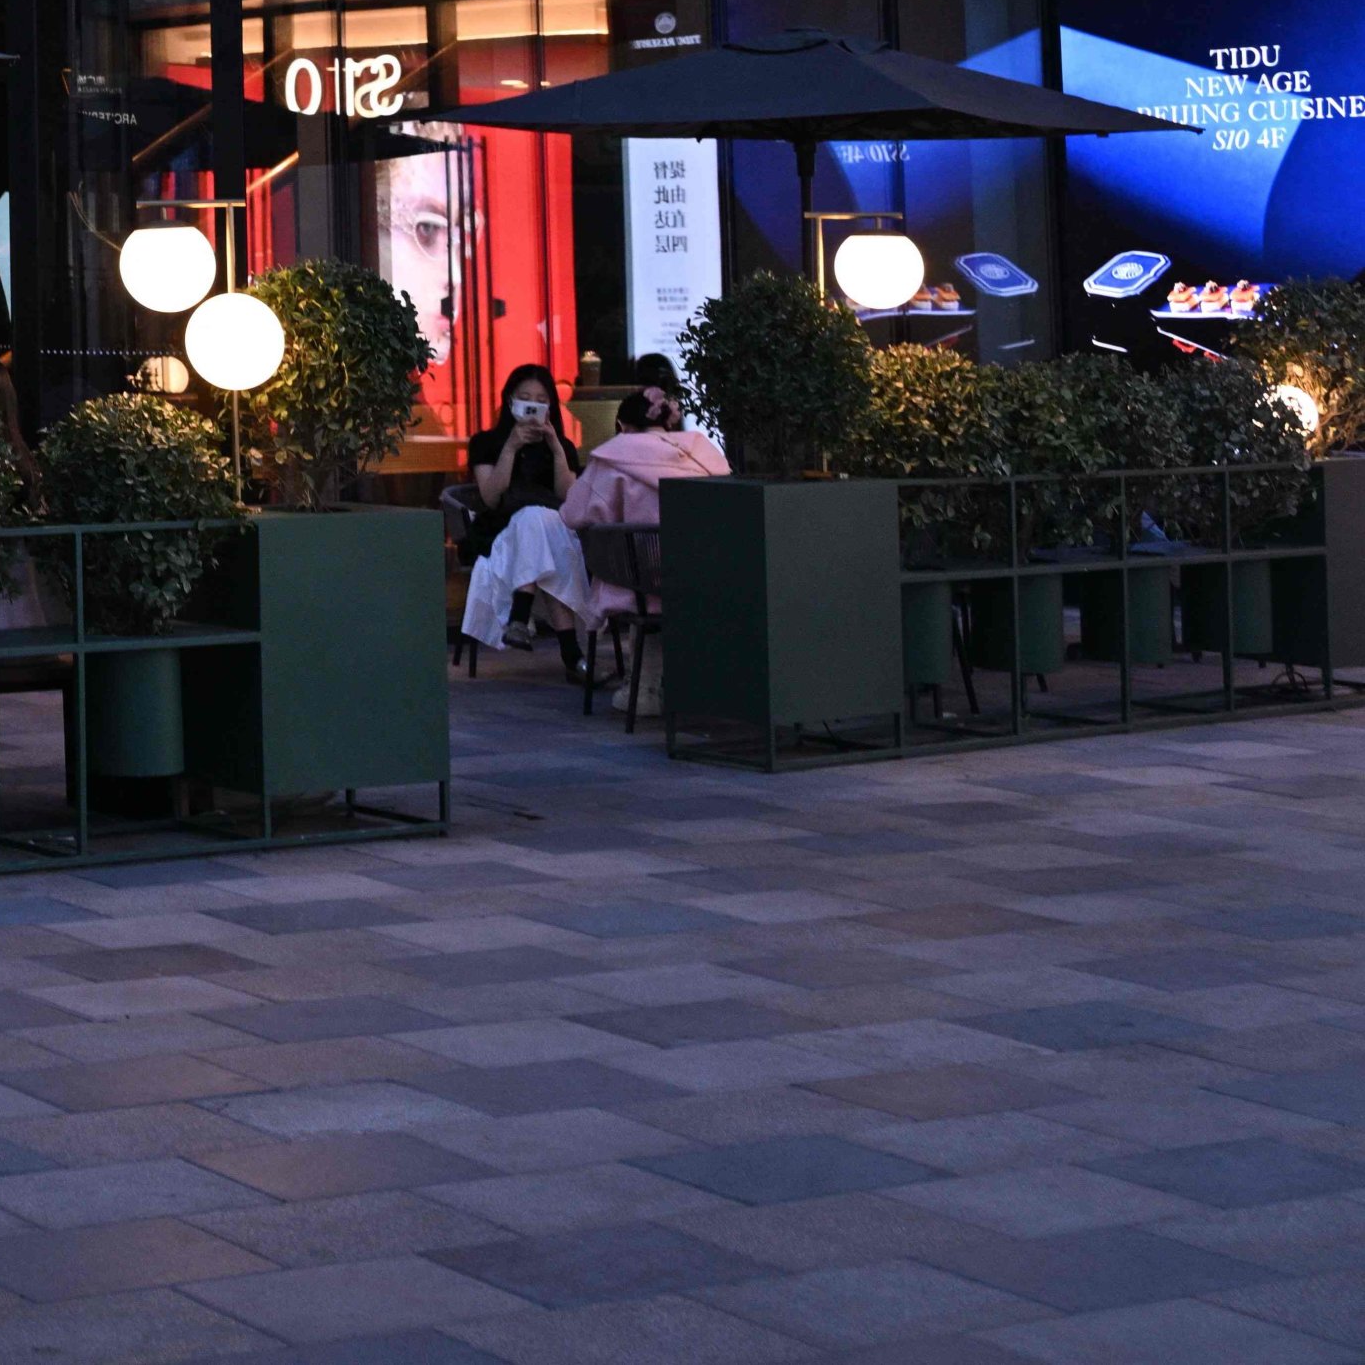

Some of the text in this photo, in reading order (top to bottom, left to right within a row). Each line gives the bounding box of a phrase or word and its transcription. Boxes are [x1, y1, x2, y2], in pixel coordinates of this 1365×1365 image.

[1209, 44, 1281, 70] TIDU
[1185, 70, 1312, 98] NEW AGE
[1247, 95, 1365, 122] CUISINE
[1212, 127, 1288, 151] S10 4F
